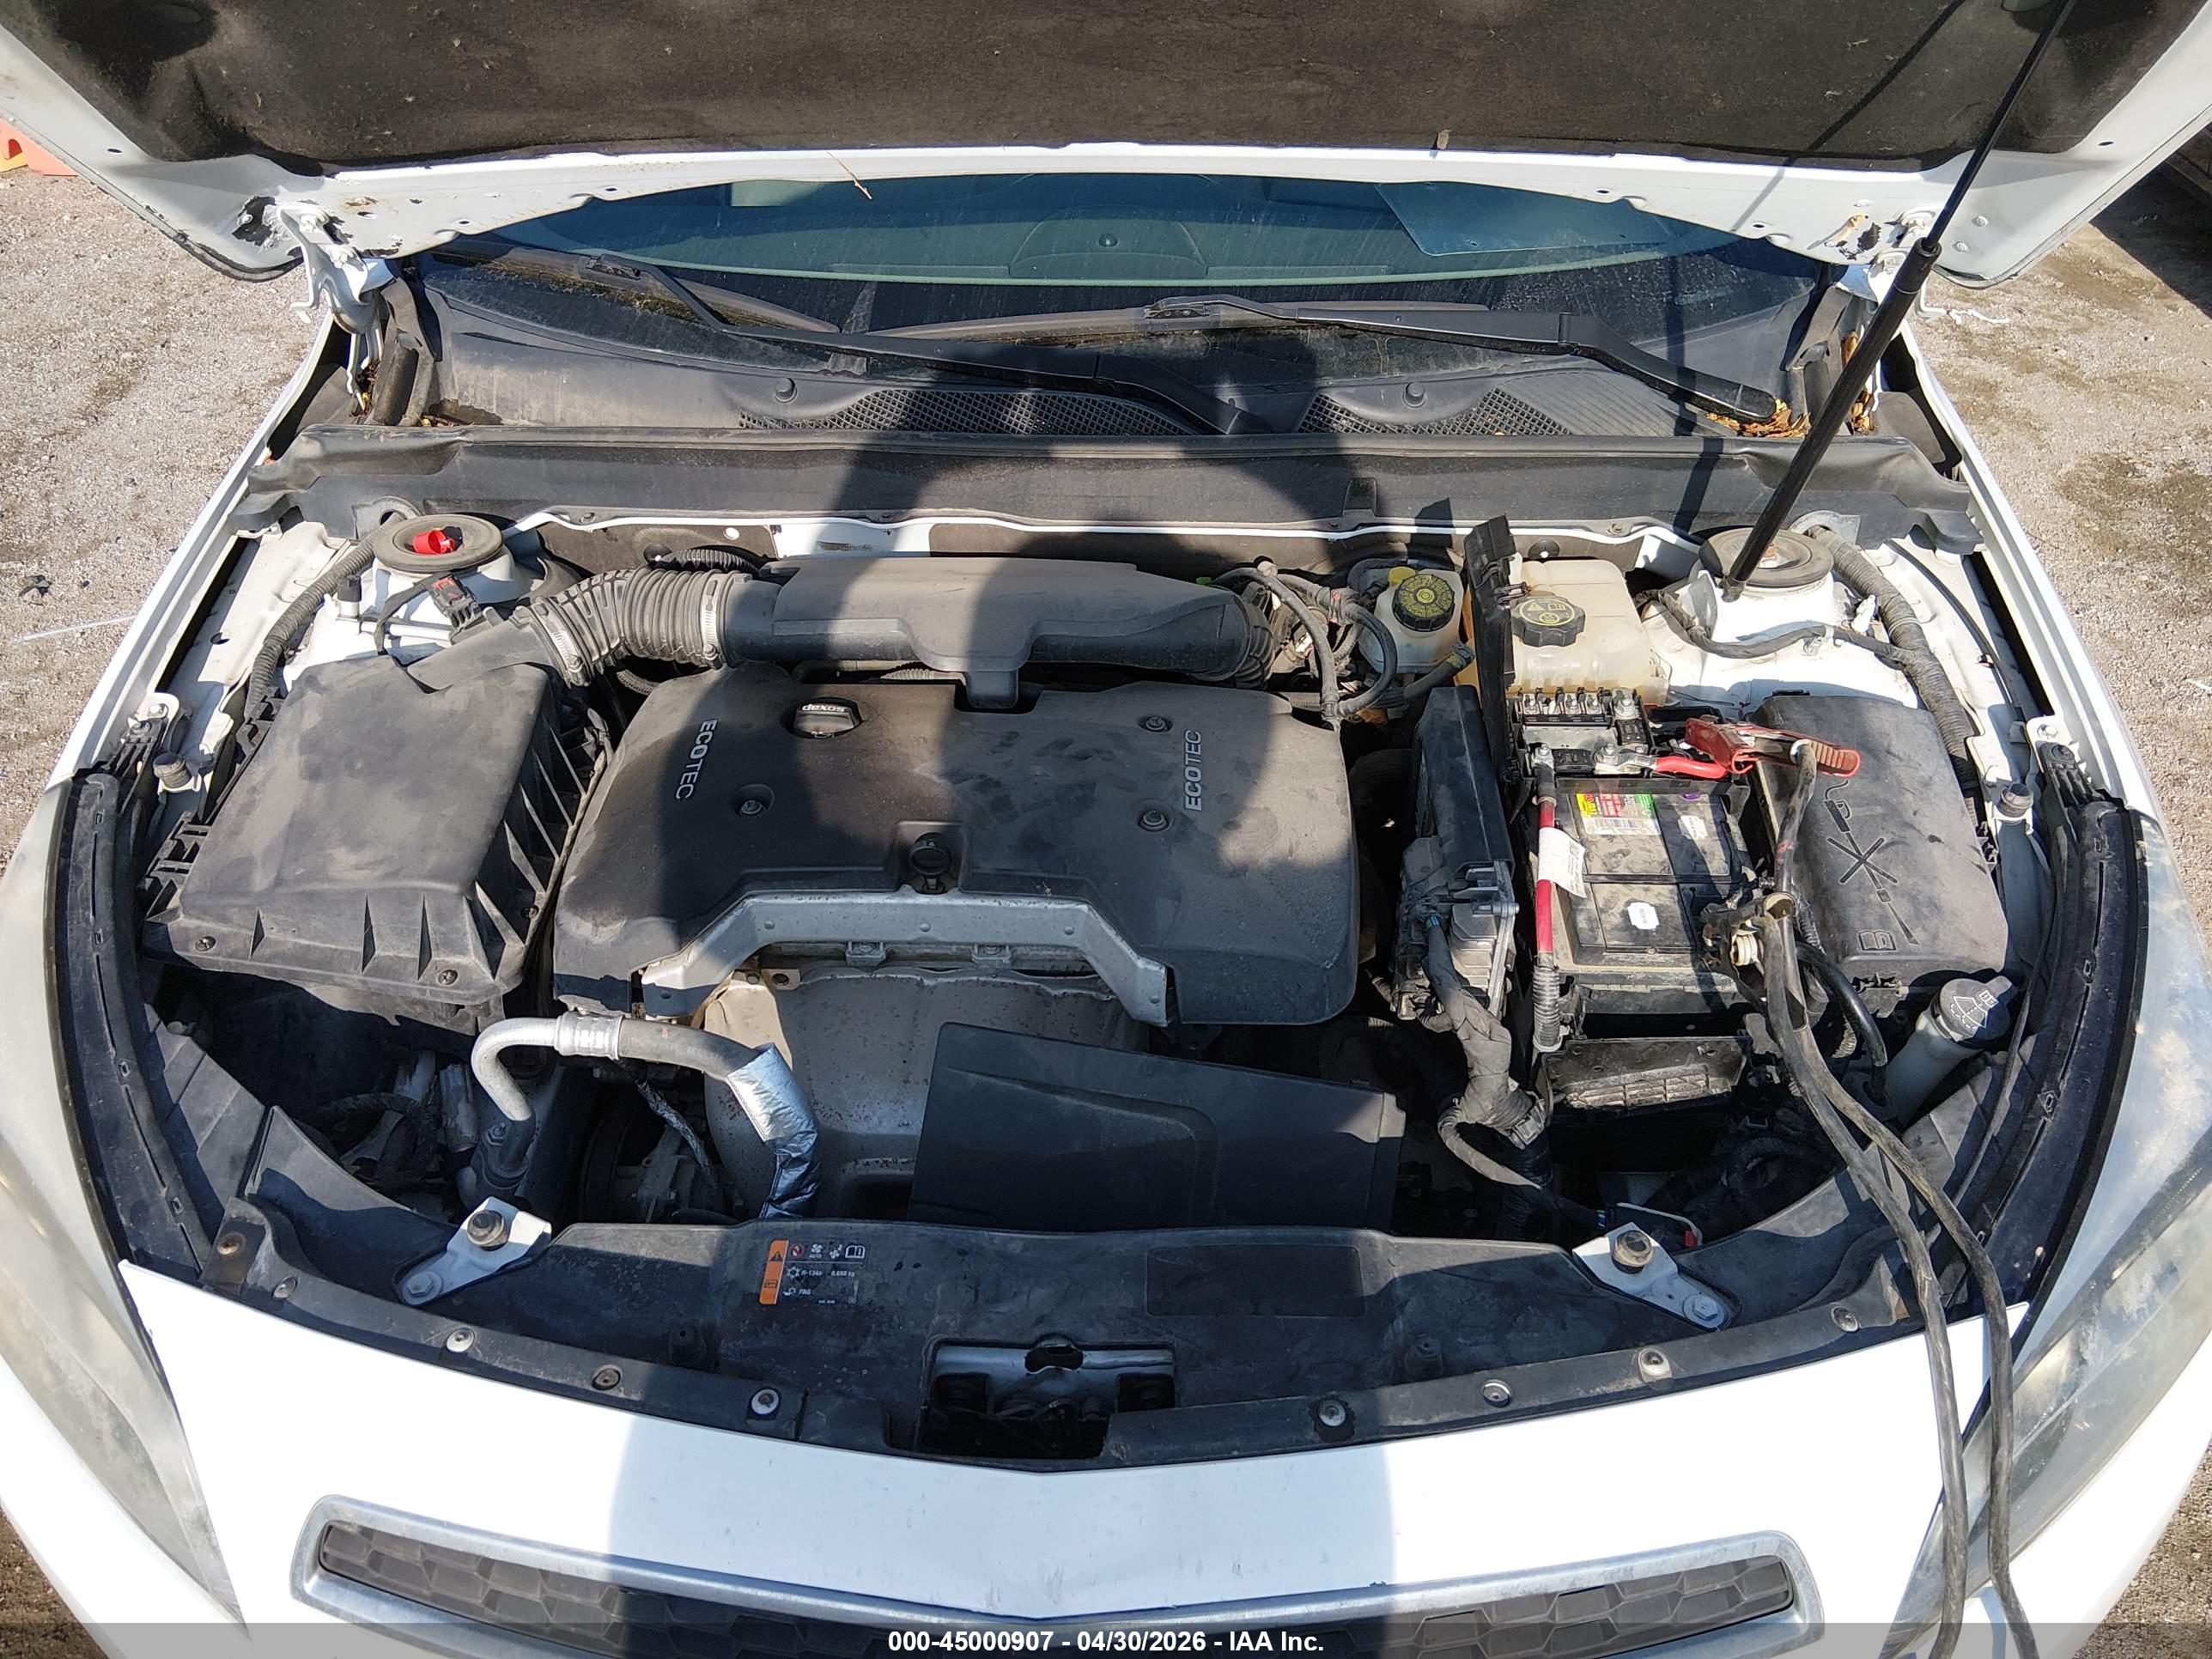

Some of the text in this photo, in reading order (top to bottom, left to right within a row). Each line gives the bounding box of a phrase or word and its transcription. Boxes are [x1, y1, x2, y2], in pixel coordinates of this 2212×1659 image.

[802, 703, 845, 713] dexos
[676, 720, 719, 799] ECOTEC
[1185, 731, 1202, 811] ECOTEC
